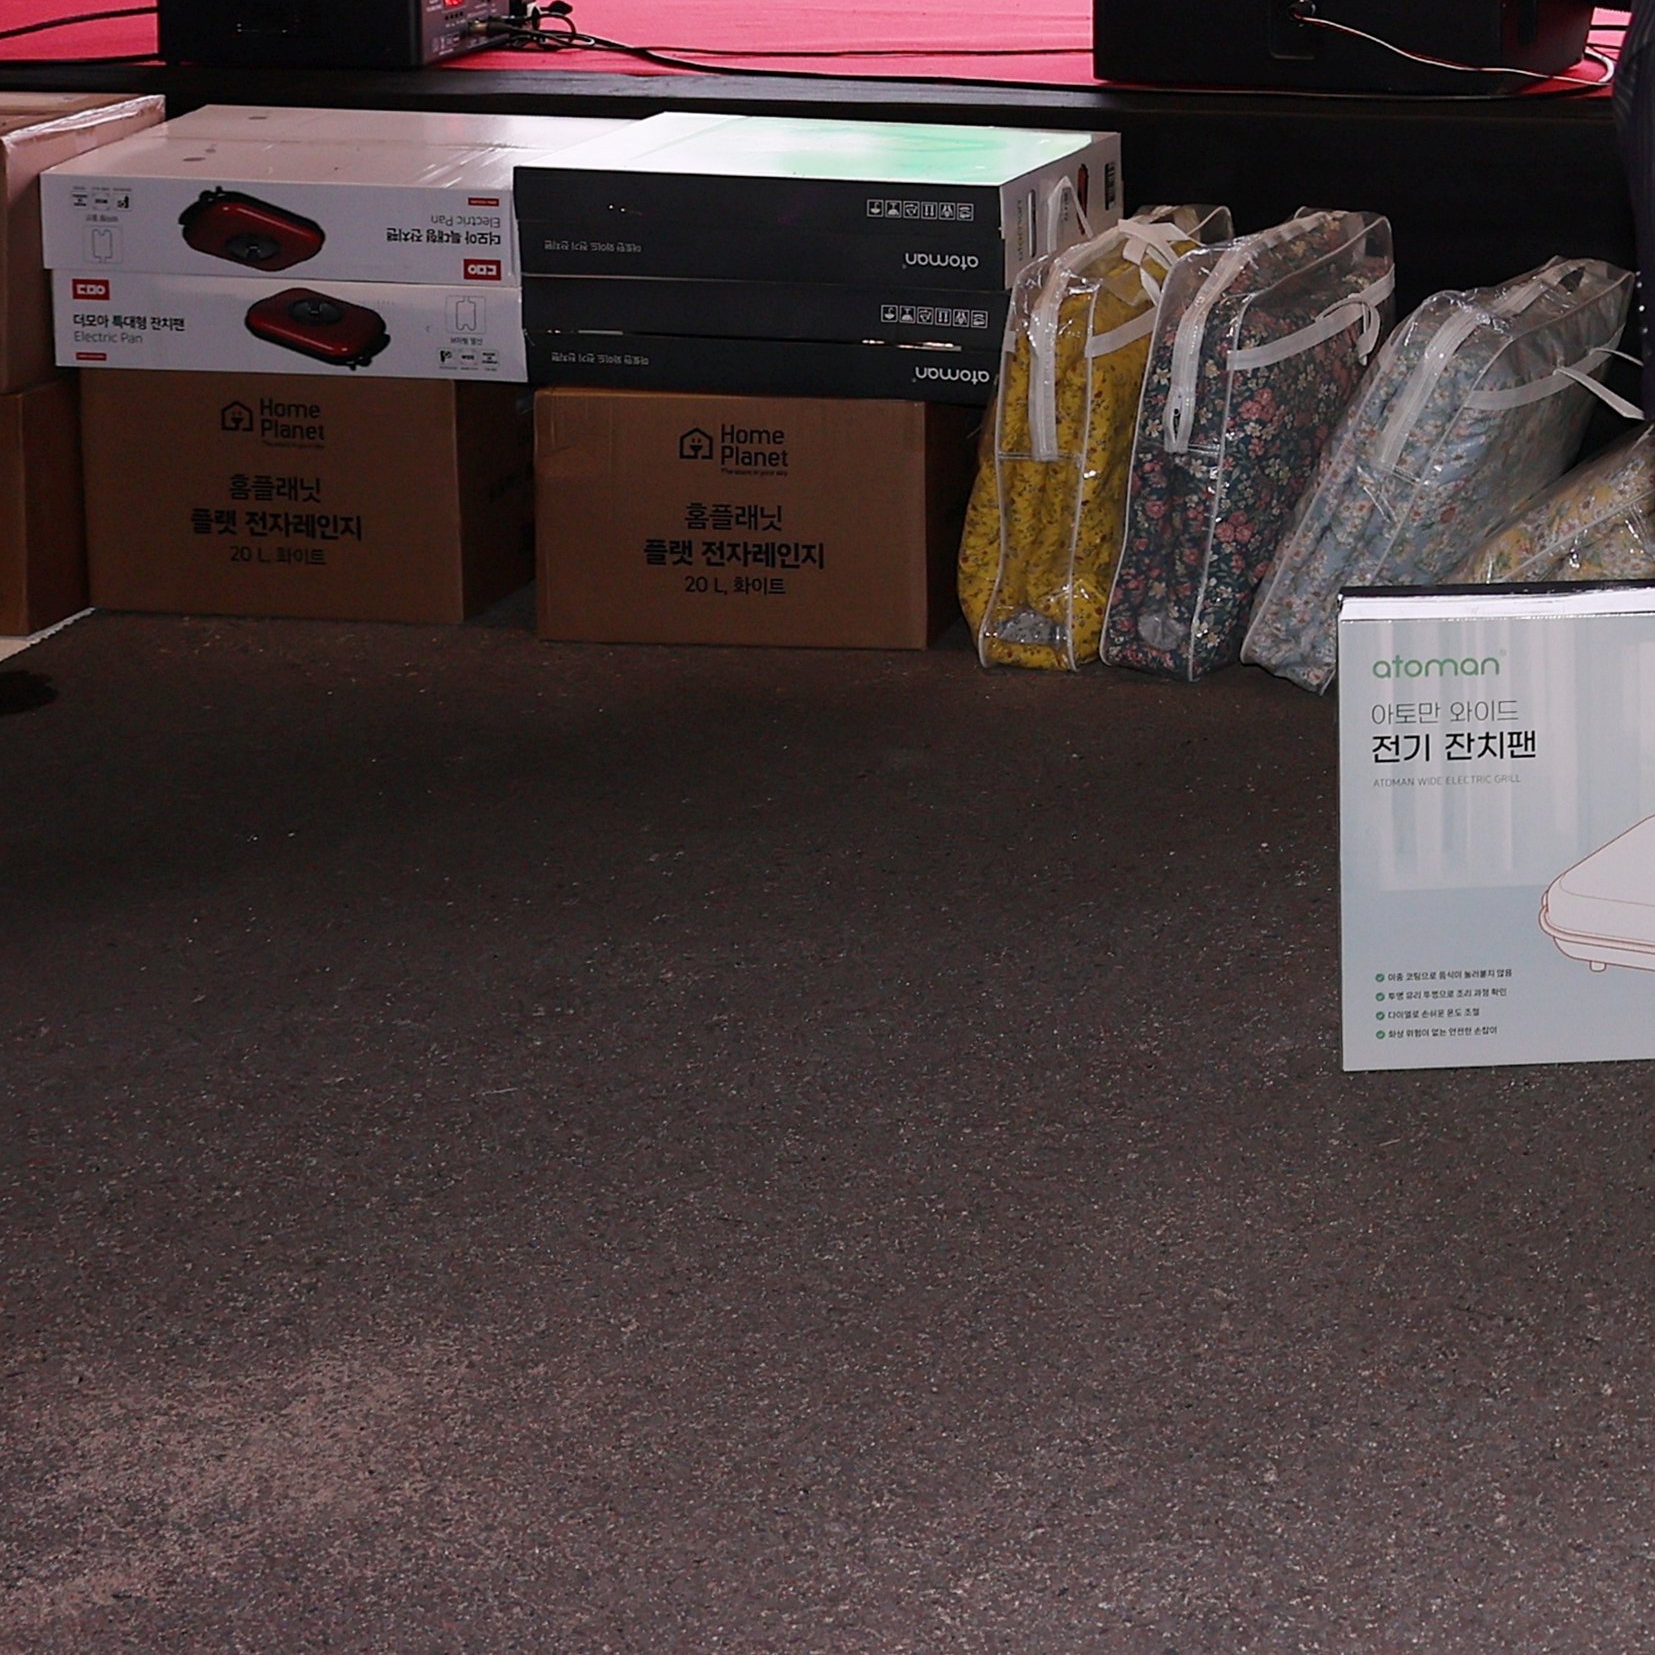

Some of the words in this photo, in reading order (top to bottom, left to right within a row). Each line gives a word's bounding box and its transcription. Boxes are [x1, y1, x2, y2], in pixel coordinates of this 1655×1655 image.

[431, 215, 453, 226] Pan
[457, 216, 500, 228] Electric
[386, 228, 423, 242] 잔치팬
[426, 229, 461, 244] 특대형
[465, 231, 501, 245] 더모아
[906, 251, 978, 271] atoman
[74, 314, 108, 327] 더모아
[112, 315, 146, 329] 특대형
[150, 317, 185, 331] 잔치팬
[74, 331, 117, 342] Electric
[121, 333, 143, 343] Pan
[916, 366, 989, 383] atoman
[260, 398, 320, 418] Home
[261, 419, 324, 440] Planet
[721, 424, 784, 444] Home
[721, 445, 788, 467] Planet
[230, 474, 321, 503] 홈플래닛
[191, 508, 236, 535] 플랫
[245, 512, 362, 541] 전자레인지
[685, 502, 784, 533] 홈플래닛
[230, 546, 251, 562] 20
[277, 547, 326, 564] 화이트
[643, 540, 694, 566] 플랫
[702, 542, 825, 570] 전자레인지
[685, 577, 710, 594] 20
[733, 577, 785, 595] 화이트
[1373, 654, 1501, 678] atoman
[1371, 703, 1440, 725] 아토만
[1450, 699, 1519, 722] 와이드
[1372, 733, 1430, 763] 전기
[1444, 730, 1536, 760] 잔치팬
[1373, 777, 1414, 787] ATOMAN
[1446, 775, 1491, 785] ELECTRIC
